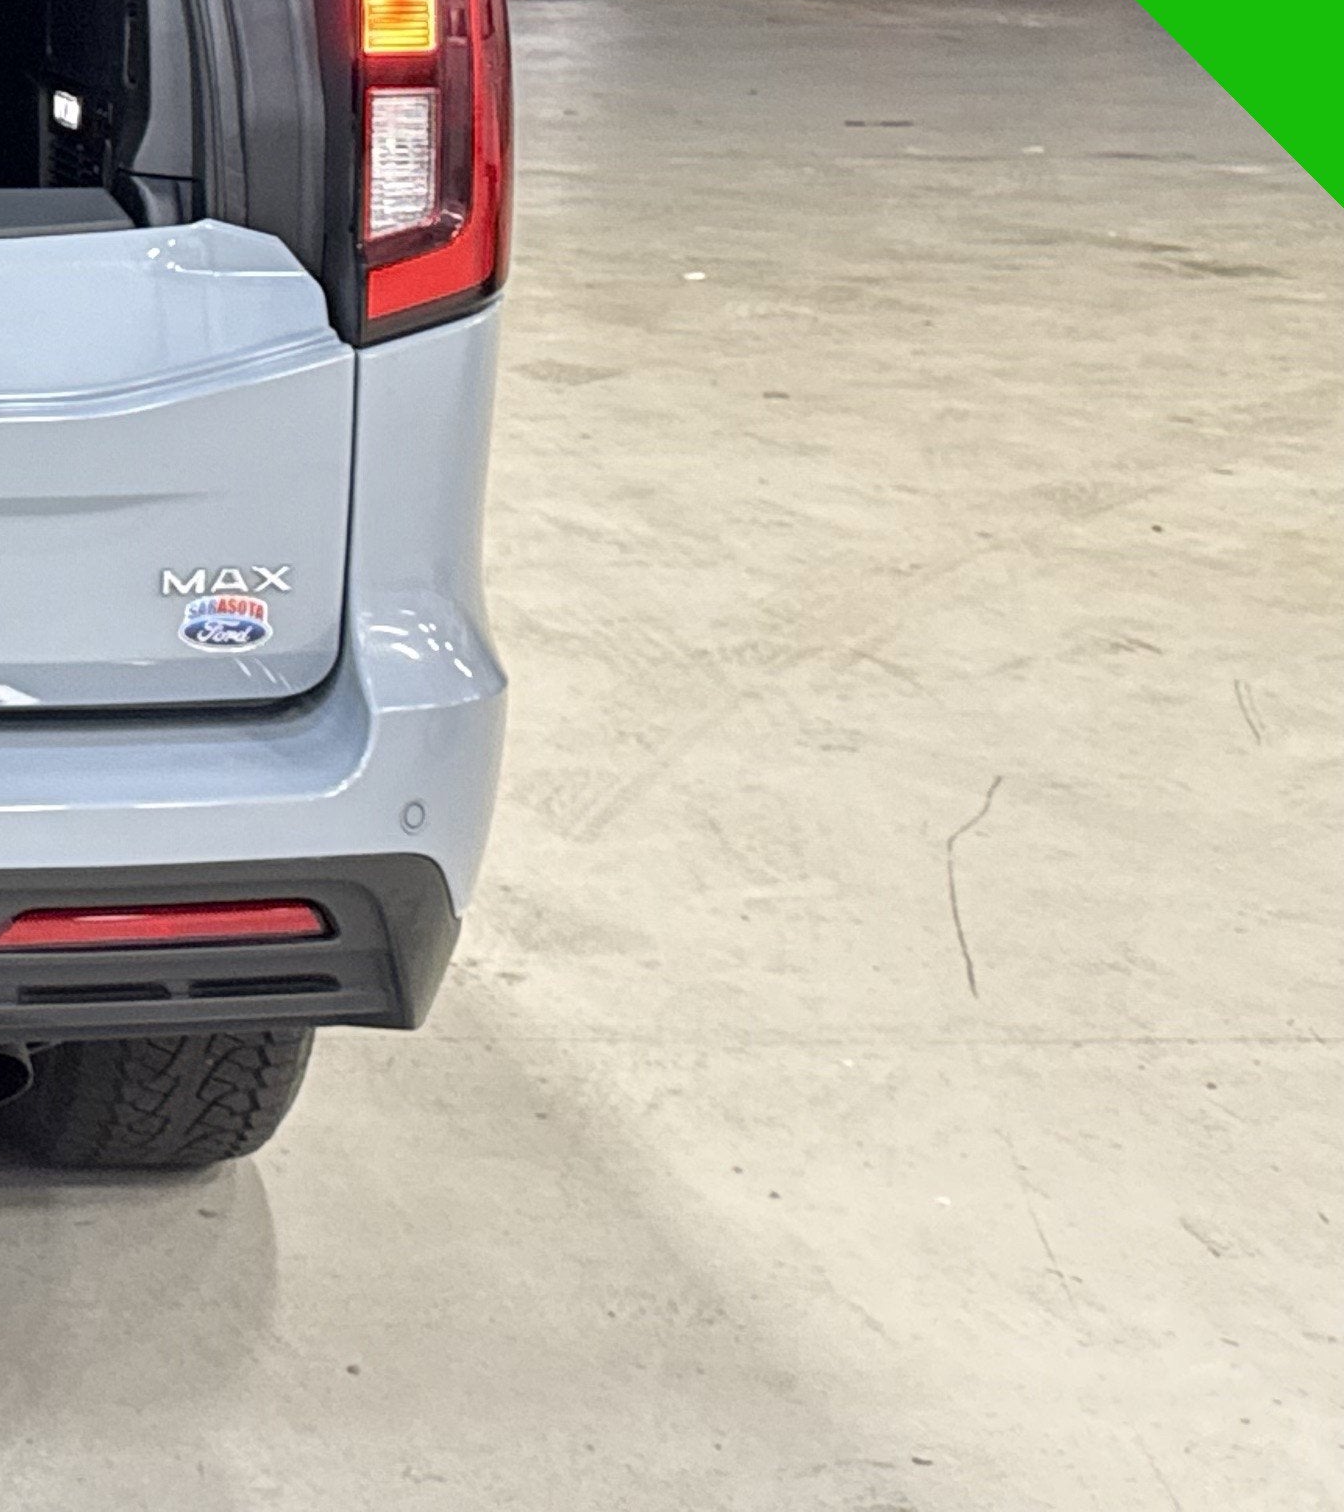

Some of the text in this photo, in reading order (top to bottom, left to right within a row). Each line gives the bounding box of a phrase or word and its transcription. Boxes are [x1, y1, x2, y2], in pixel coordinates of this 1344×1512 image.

[162, 565, 293, 595] MAX
[187, 598, 265, 620] SARASOTA
[196, 621, 254, 643] Ford
